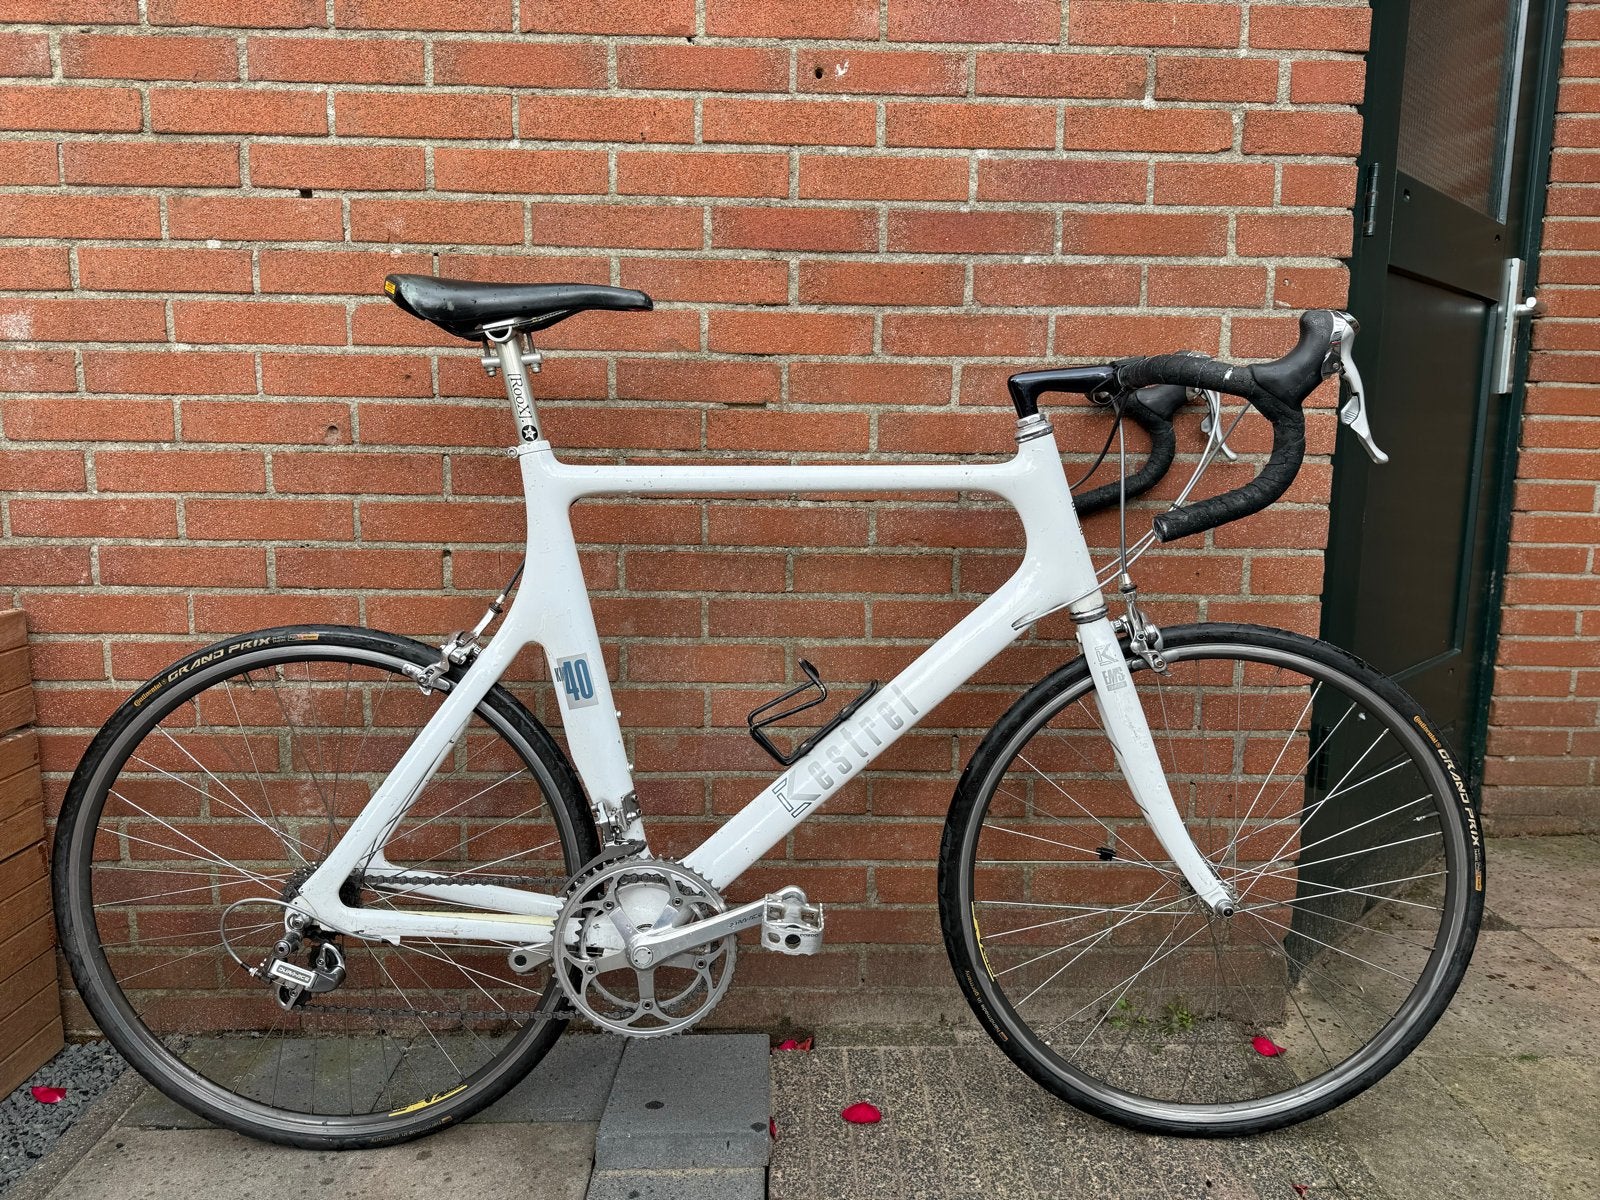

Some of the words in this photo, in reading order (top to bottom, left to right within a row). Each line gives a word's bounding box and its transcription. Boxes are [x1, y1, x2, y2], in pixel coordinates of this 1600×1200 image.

[133, 681, 162, 707] Continental
[167, 648, 225, 683] GRAND
[228, 636, 272, 654] PRIX
[563, 659, 594, 701] 40
[771, 684, 919, 819] Kestrel
[1412, 714, 1439, 744] Continental
[1437, 748, 1471, 804] GRAND
[1465, 807, 1480, 846] PRIX
